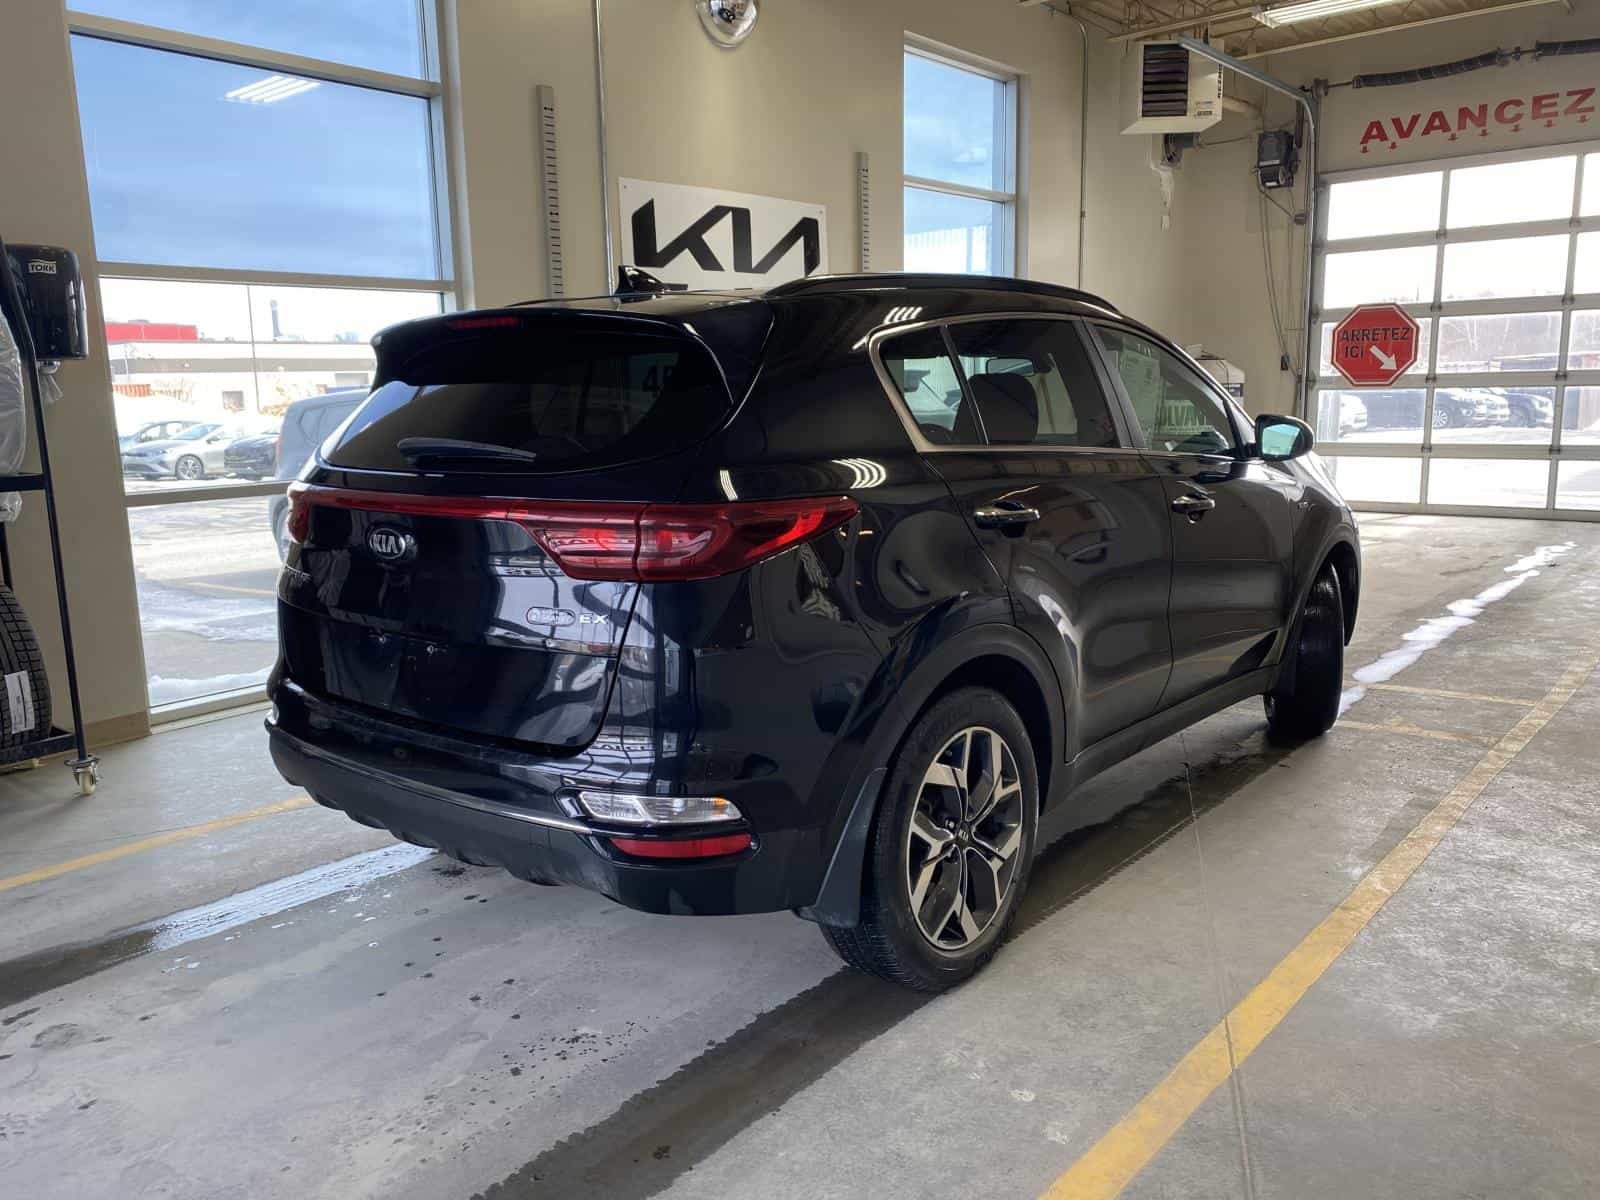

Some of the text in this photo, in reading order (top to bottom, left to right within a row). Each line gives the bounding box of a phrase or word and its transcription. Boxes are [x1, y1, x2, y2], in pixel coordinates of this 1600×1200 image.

[1359, 87, 1596, 145] AVANCEZ
[631, 198, 821, 277] KIA
[29, 263, 56, 273] TORK
[1341, 327, 1411, 342] ARRETEZ
[1345, 345, 1364, 359] ICI
[371, 534, 399, 554] KIA
[579, 614, 608, 625] EX
